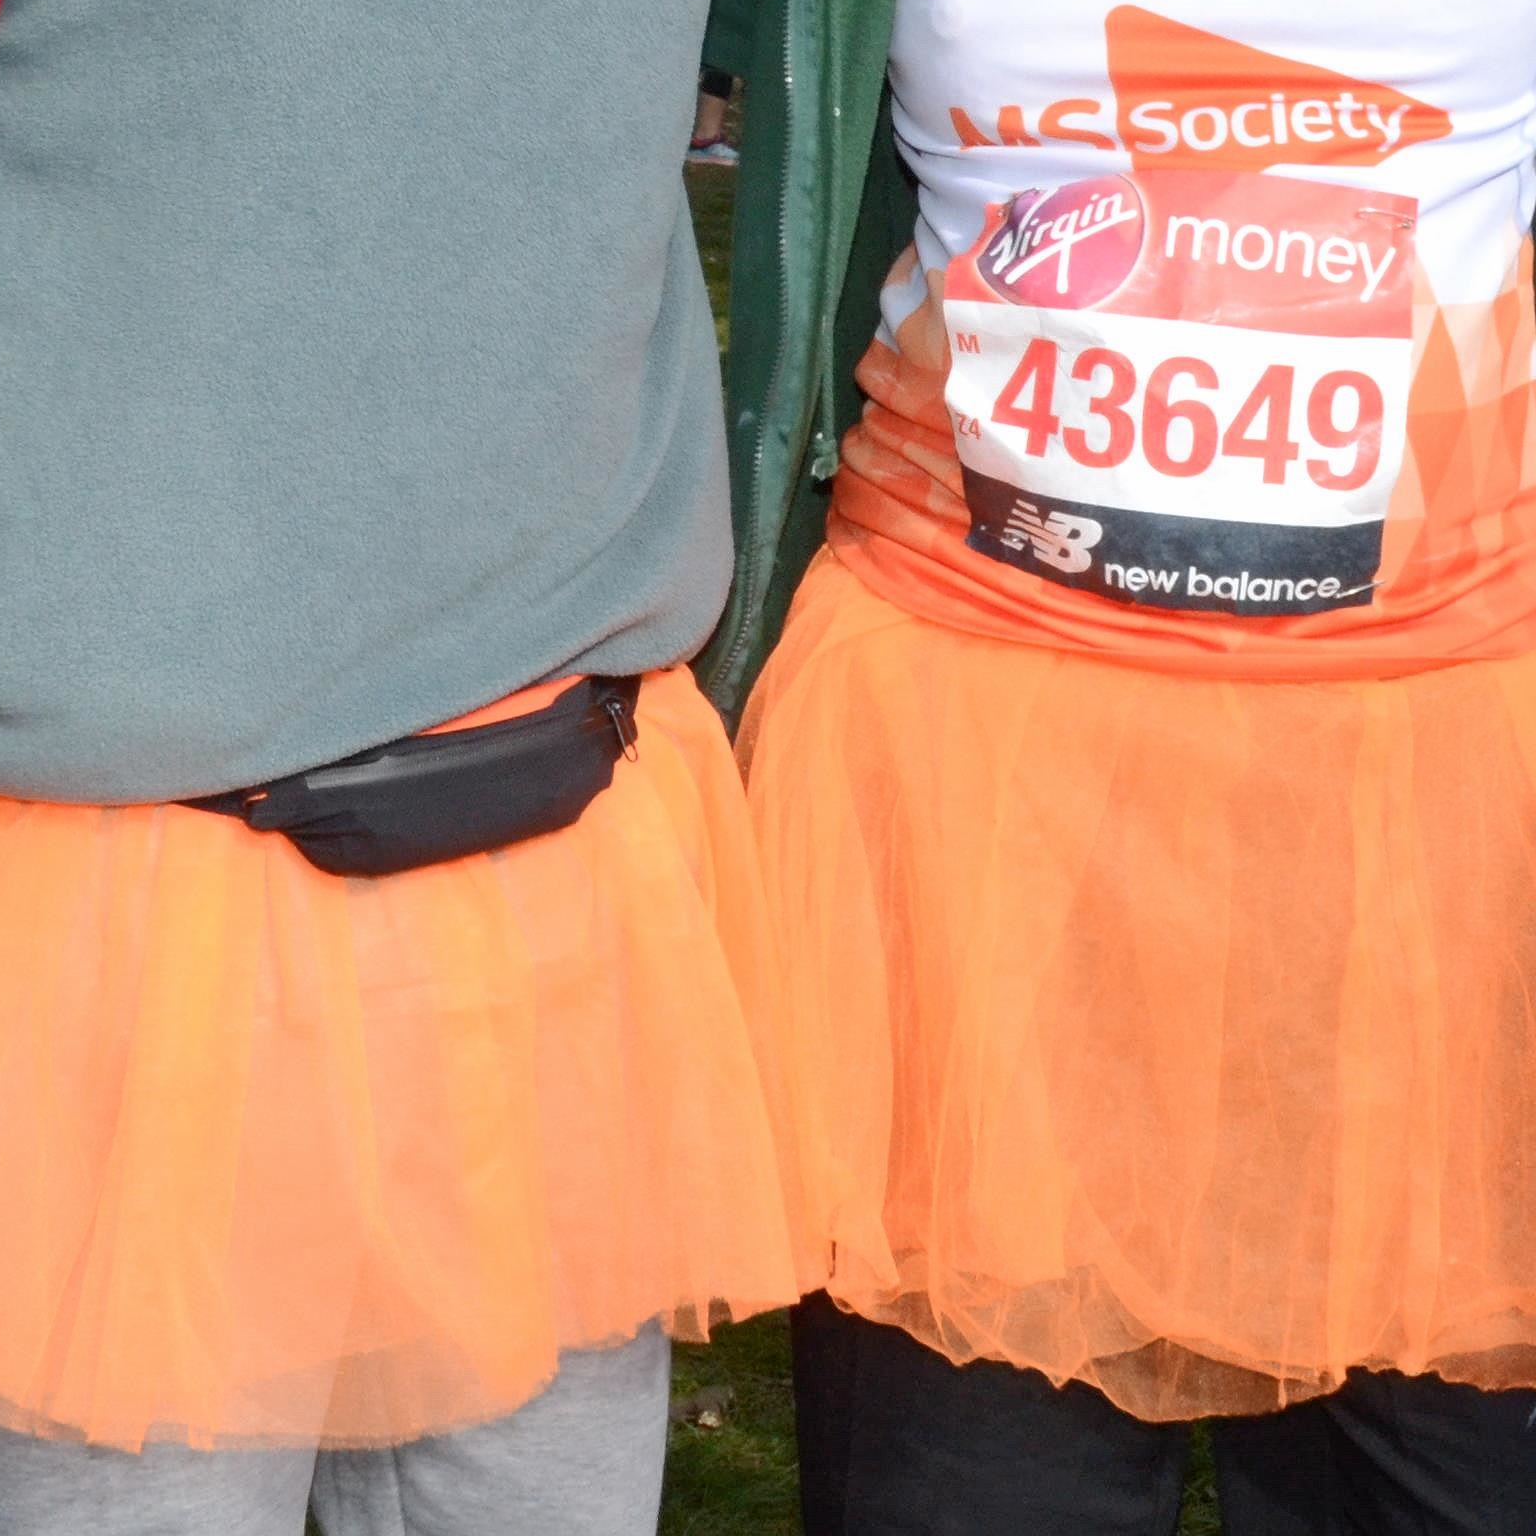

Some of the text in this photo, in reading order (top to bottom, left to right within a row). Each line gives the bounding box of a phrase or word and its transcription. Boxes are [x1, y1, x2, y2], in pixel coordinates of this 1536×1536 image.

[1129, 91, 1411, 154] Society
[990, 188, 1395, 302] Virgin money
[956, 332, 981, 354] M
[991, 337, 1385, 491] 43649
[1105, 563, 1341, 601] new balance
